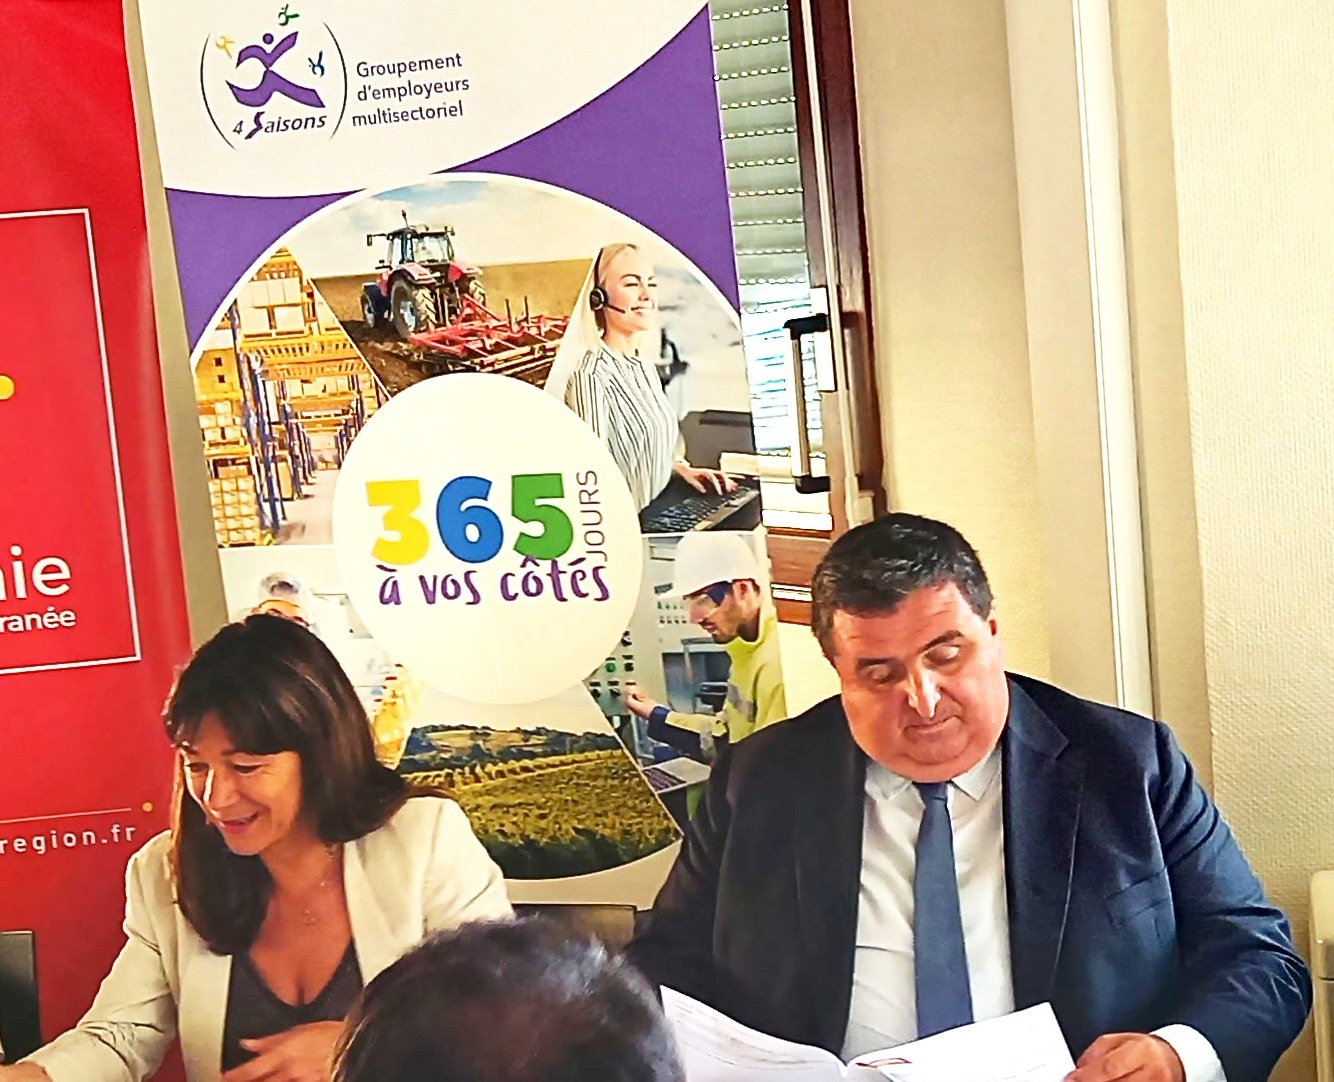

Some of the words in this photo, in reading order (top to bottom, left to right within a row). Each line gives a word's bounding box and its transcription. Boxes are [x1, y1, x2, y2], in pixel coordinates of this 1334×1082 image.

[356, 53, 463, 79] Groupement
[357, 77, 470, 104] d'employeurs
[232, 120, 244, 135] 4
[244, 111, 328, 140] Saisons
[352, 100, 464, 127] multisectoriel
[365, 473, 574, 566] 365
[576, 470, 608, 562] JOURS
[375, 564, 402, 606] à
[418, 570, 481, 606] vos
[500, 556, 610, 603] côtés
